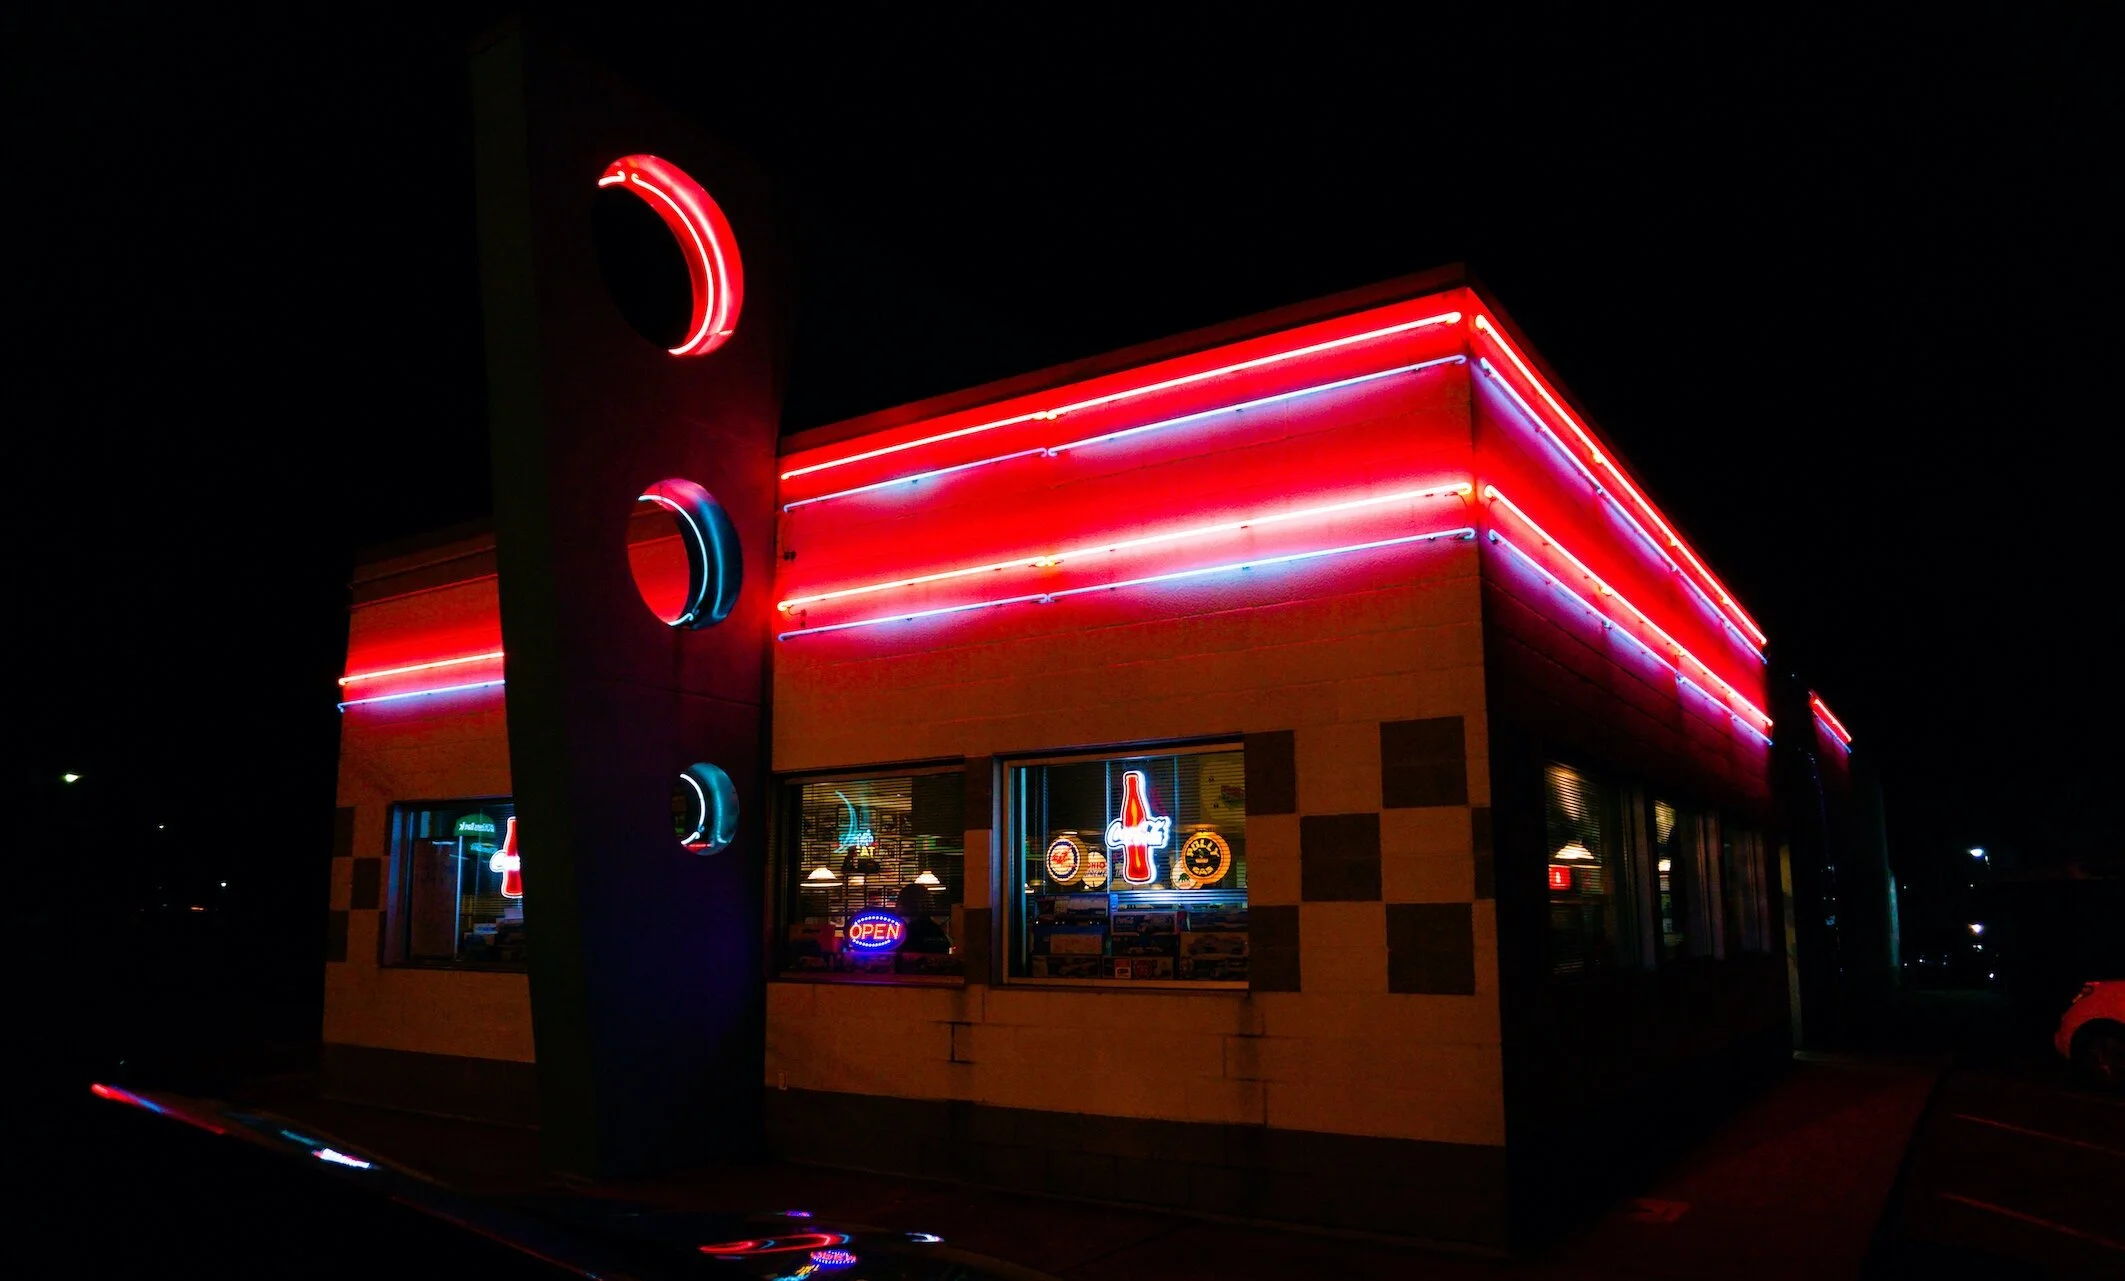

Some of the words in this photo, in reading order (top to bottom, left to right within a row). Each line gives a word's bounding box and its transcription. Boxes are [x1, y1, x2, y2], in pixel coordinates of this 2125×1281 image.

[1186, 839, 1220, 858] POLLY
[1192, 866, 1214, 876] GAS
[849, 923, 901, 940] OPEN
